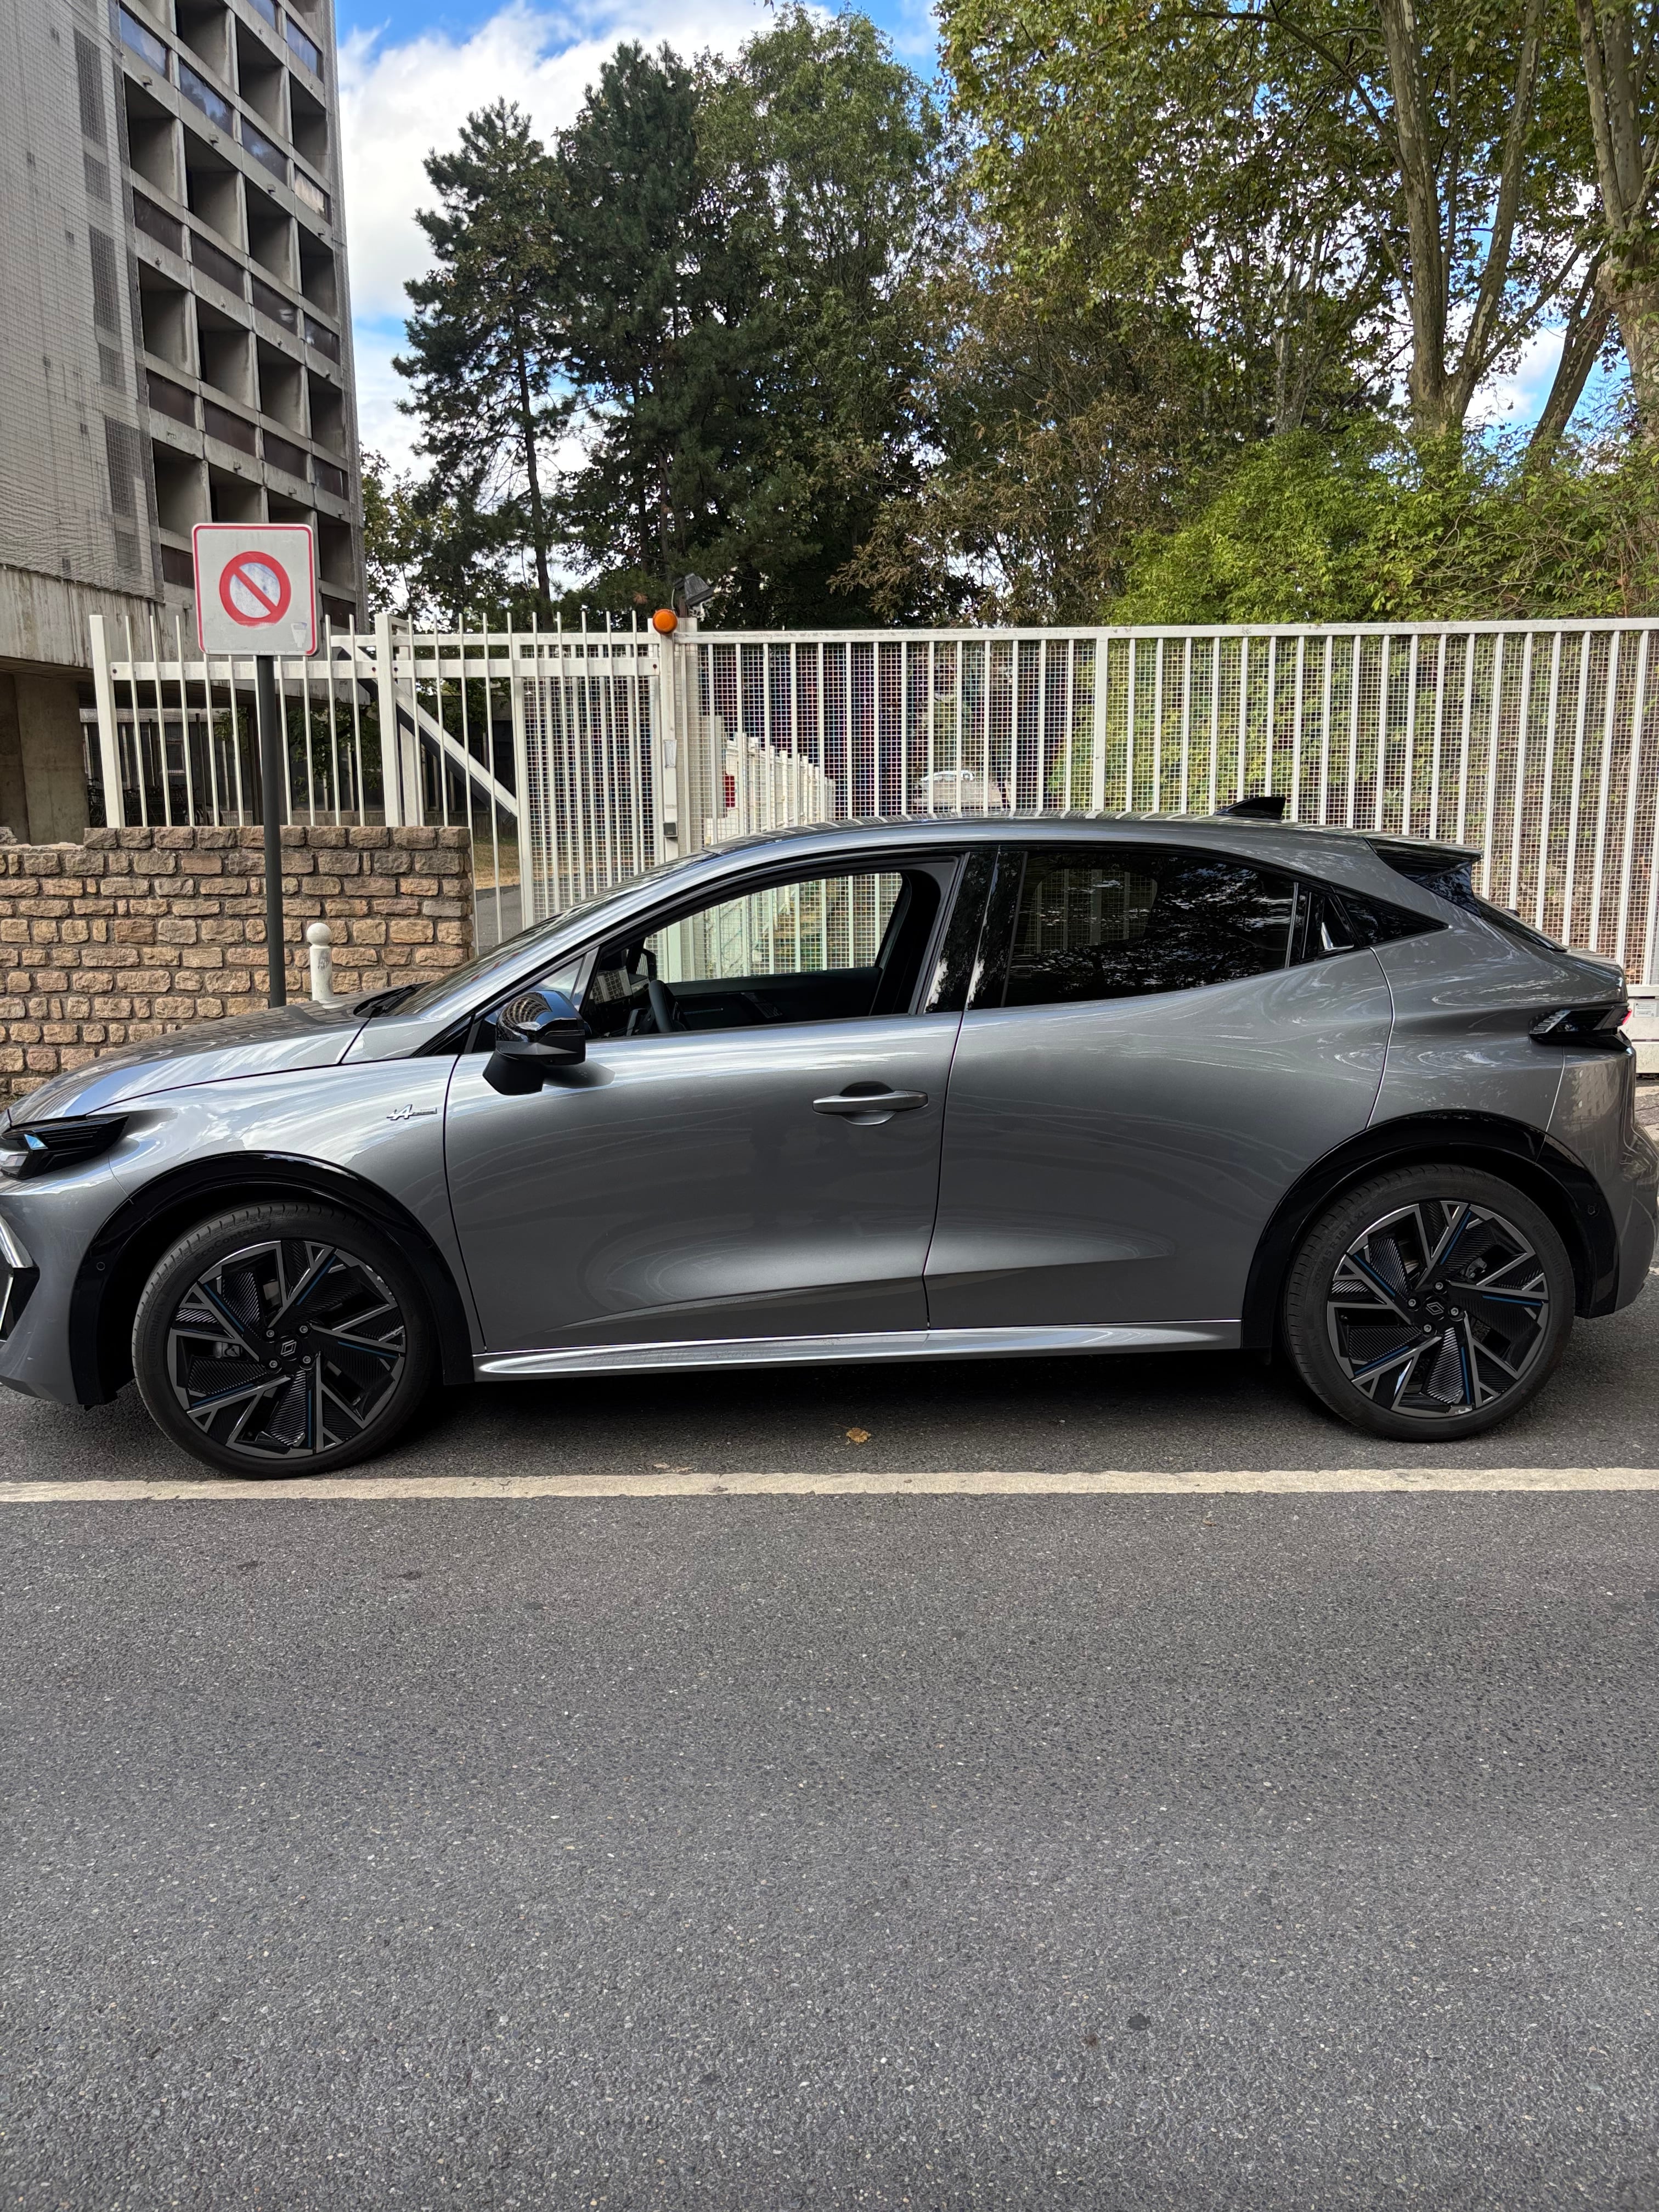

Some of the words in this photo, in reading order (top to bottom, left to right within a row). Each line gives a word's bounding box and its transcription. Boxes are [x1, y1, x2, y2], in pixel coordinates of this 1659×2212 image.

[192, 1224, 264, 1262] EcoContact
[1312, 1249, 1333, 1288] 205/45
[1335, 1228, 1347, 1241] 18
